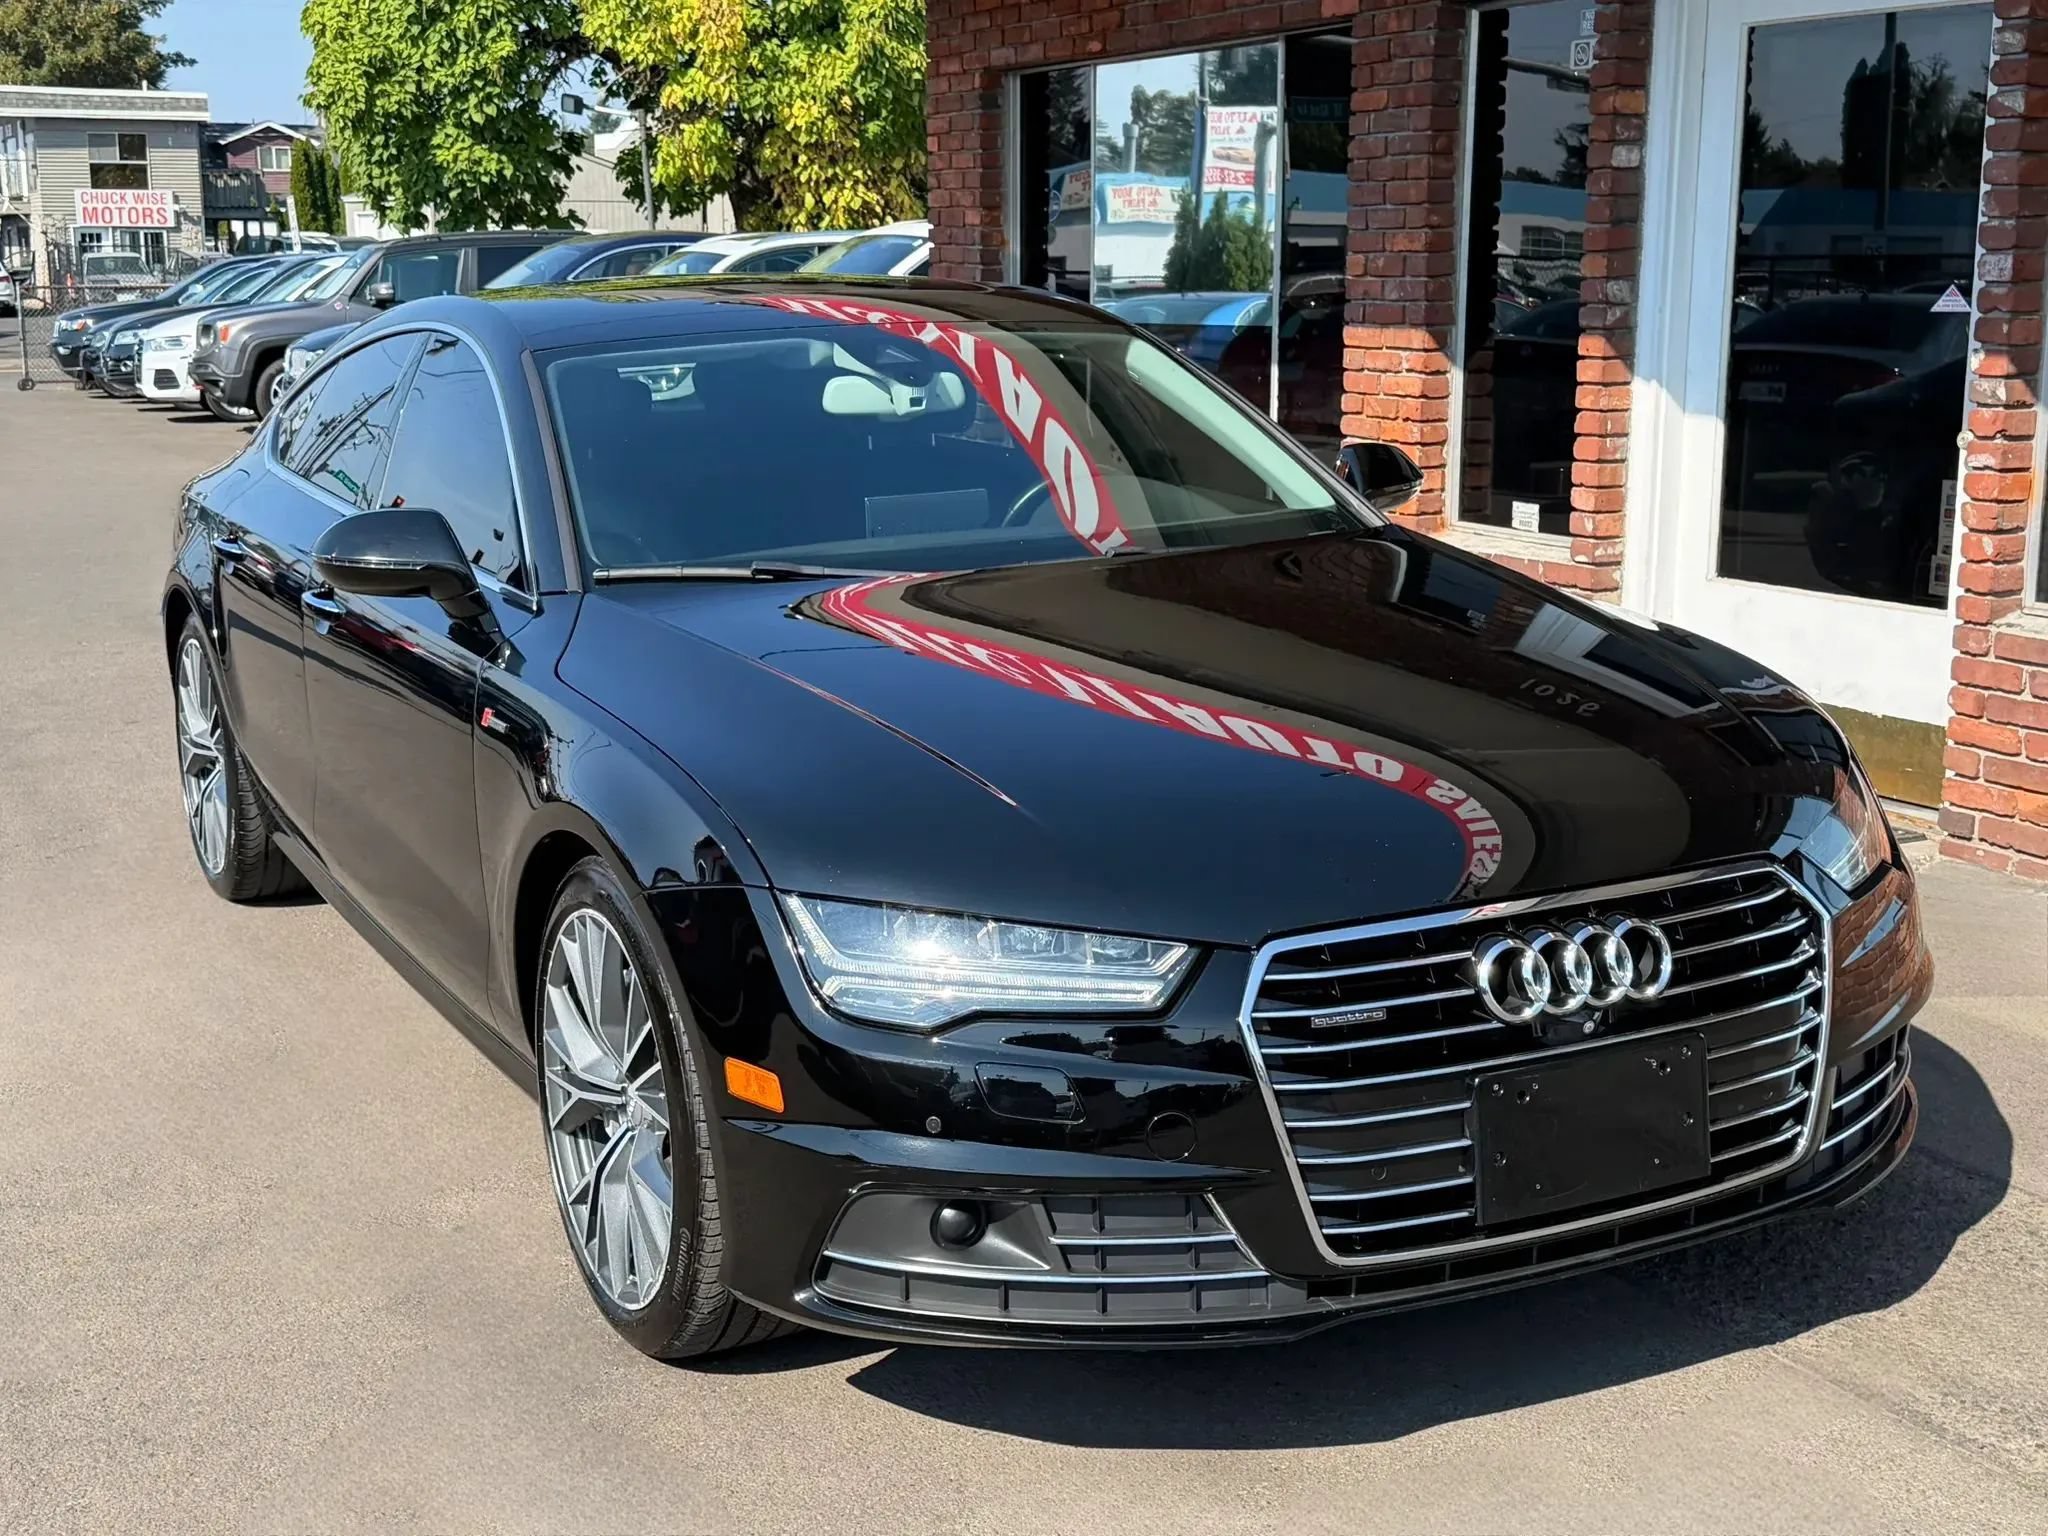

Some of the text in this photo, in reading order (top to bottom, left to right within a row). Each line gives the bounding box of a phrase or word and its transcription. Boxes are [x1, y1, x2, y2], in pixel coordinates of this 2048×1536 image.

[81, 192, 168, 206] CHUCK WISE
[82, 206, 168, 225] MOTORS
[1314, 1011, 1384, 1027] quattro
